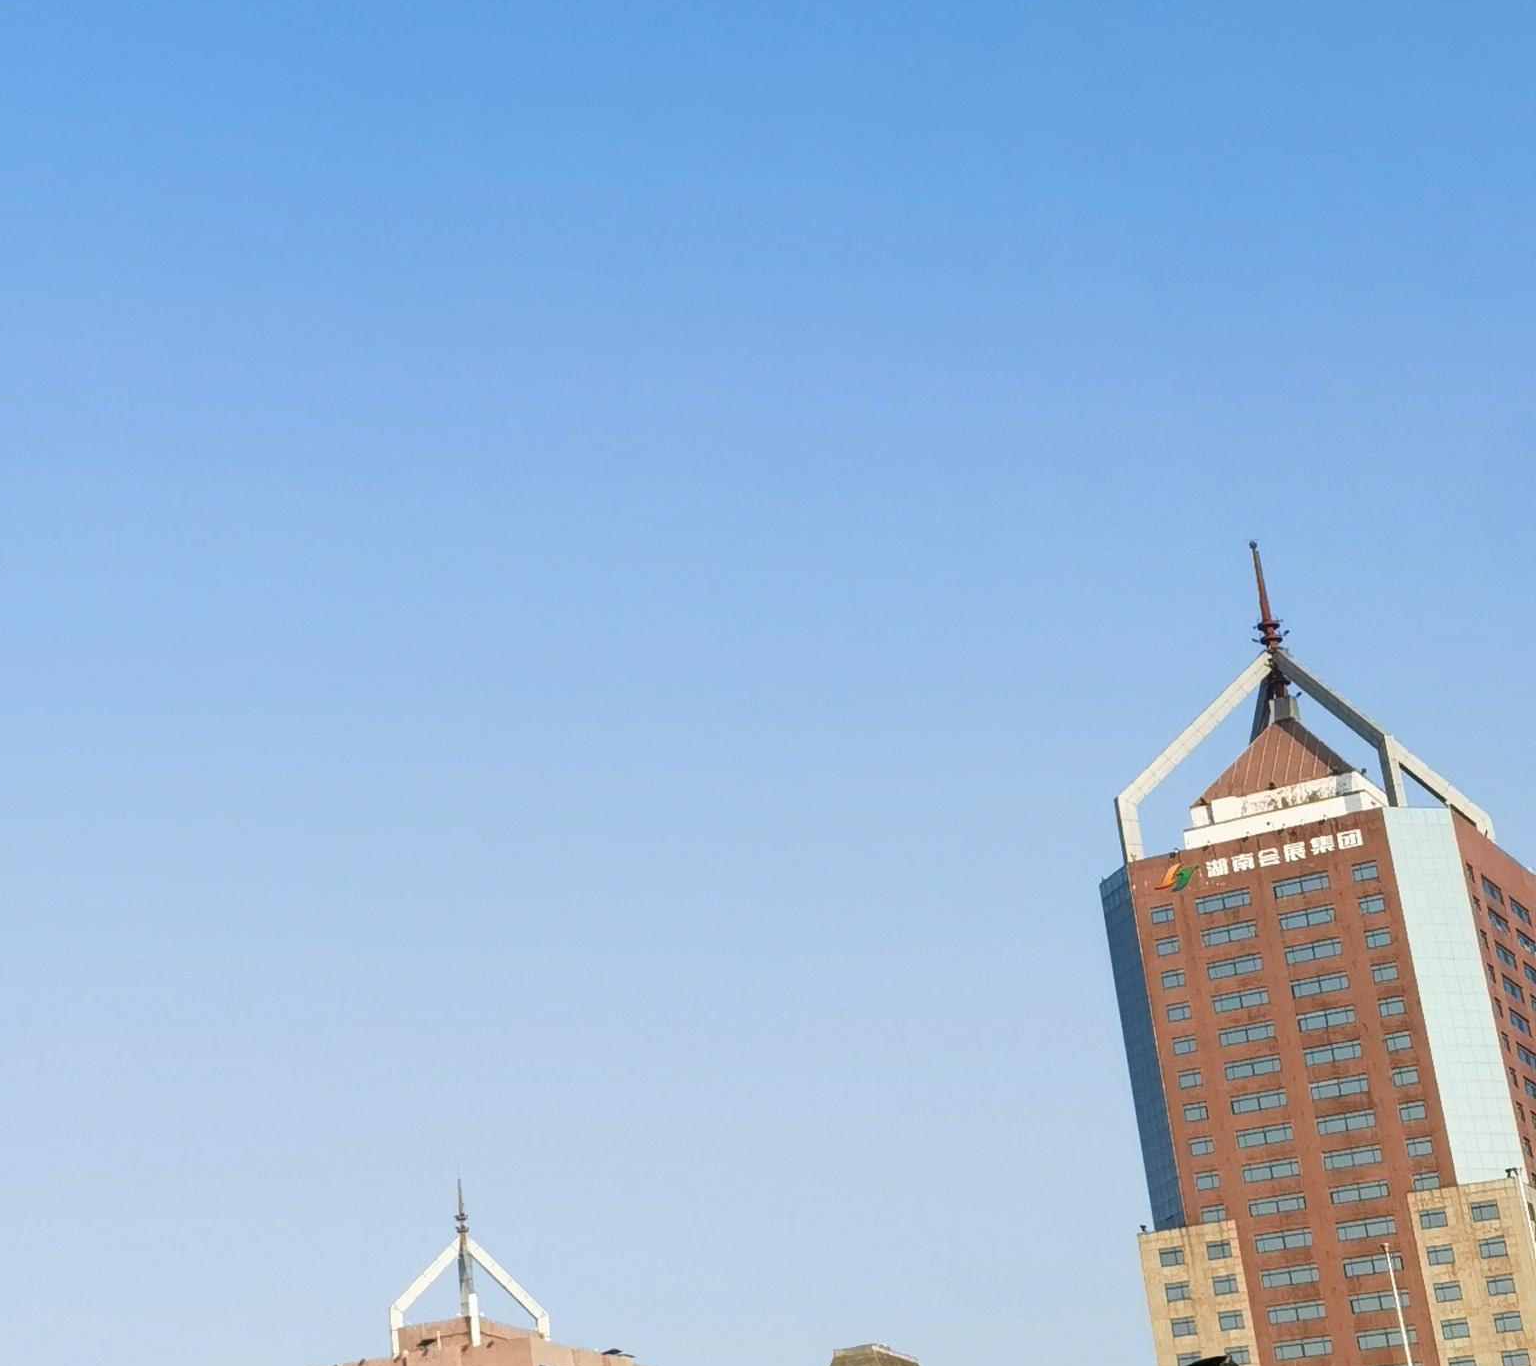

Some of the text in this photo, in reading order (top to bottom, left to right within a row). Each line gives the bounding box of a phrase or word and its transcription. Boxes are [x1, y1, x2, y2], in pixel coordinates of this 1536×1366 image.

[1205, 828, 1364, 878] 湖南会展集团
